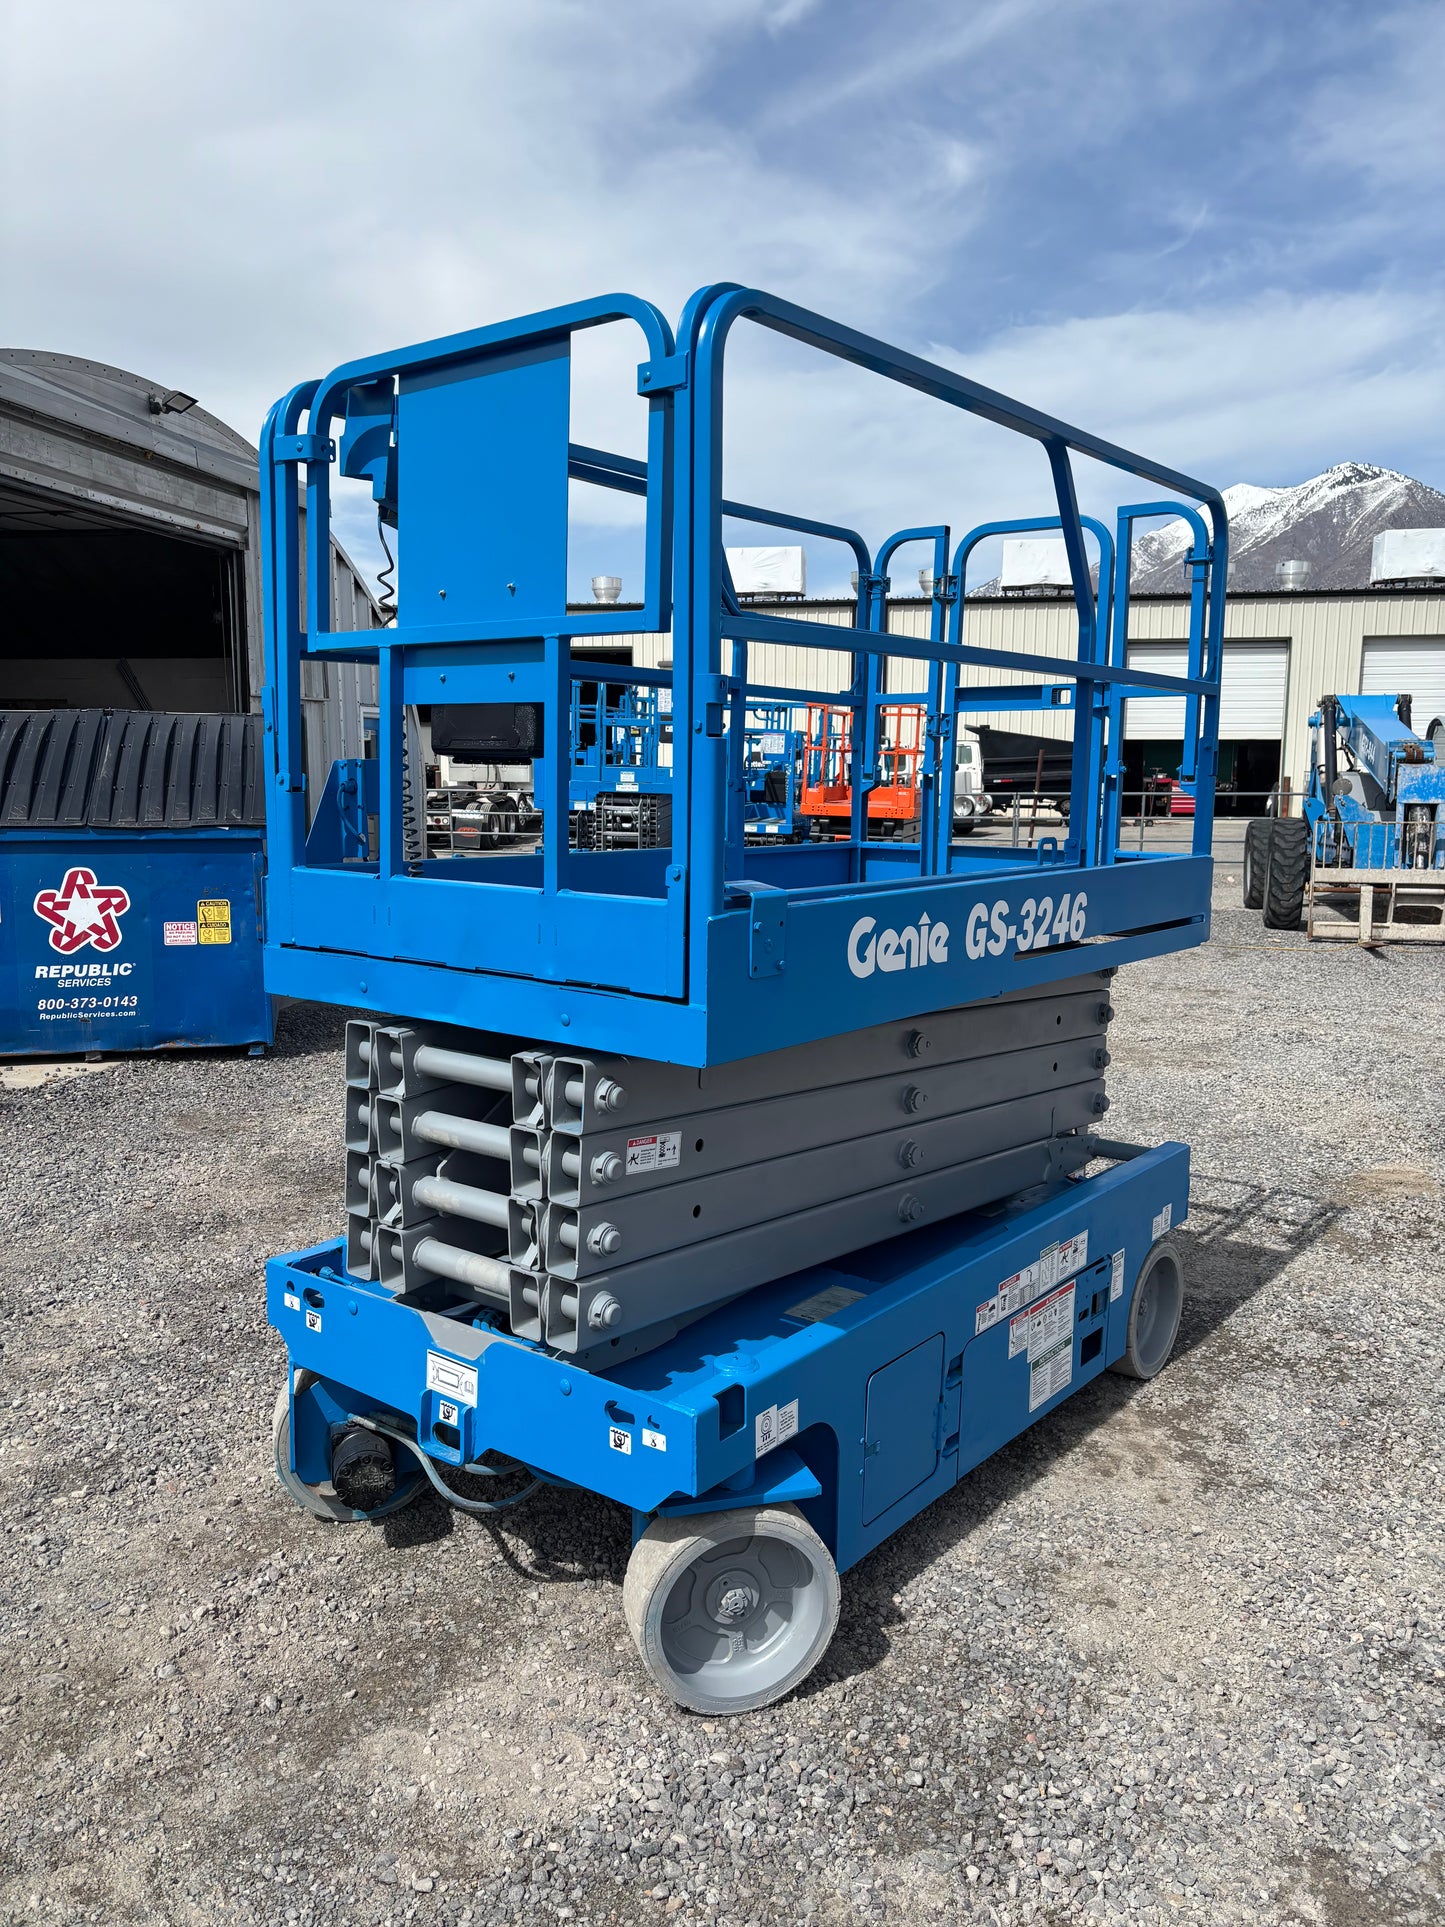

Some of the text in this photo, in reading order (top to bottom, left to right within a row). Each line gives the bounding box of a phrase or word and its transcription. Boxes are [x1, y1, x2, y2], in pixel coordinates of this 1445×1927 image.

[847, 891, 1088, 979] Genie GS-3246
[35, 963, 133, 979] REPUBLIC
[57, 978, 112, 988] SERVICES
[37, 995, 138, 1010] 800-373-0143
[39, 1010, 137, 1020] RepublicServices.com
